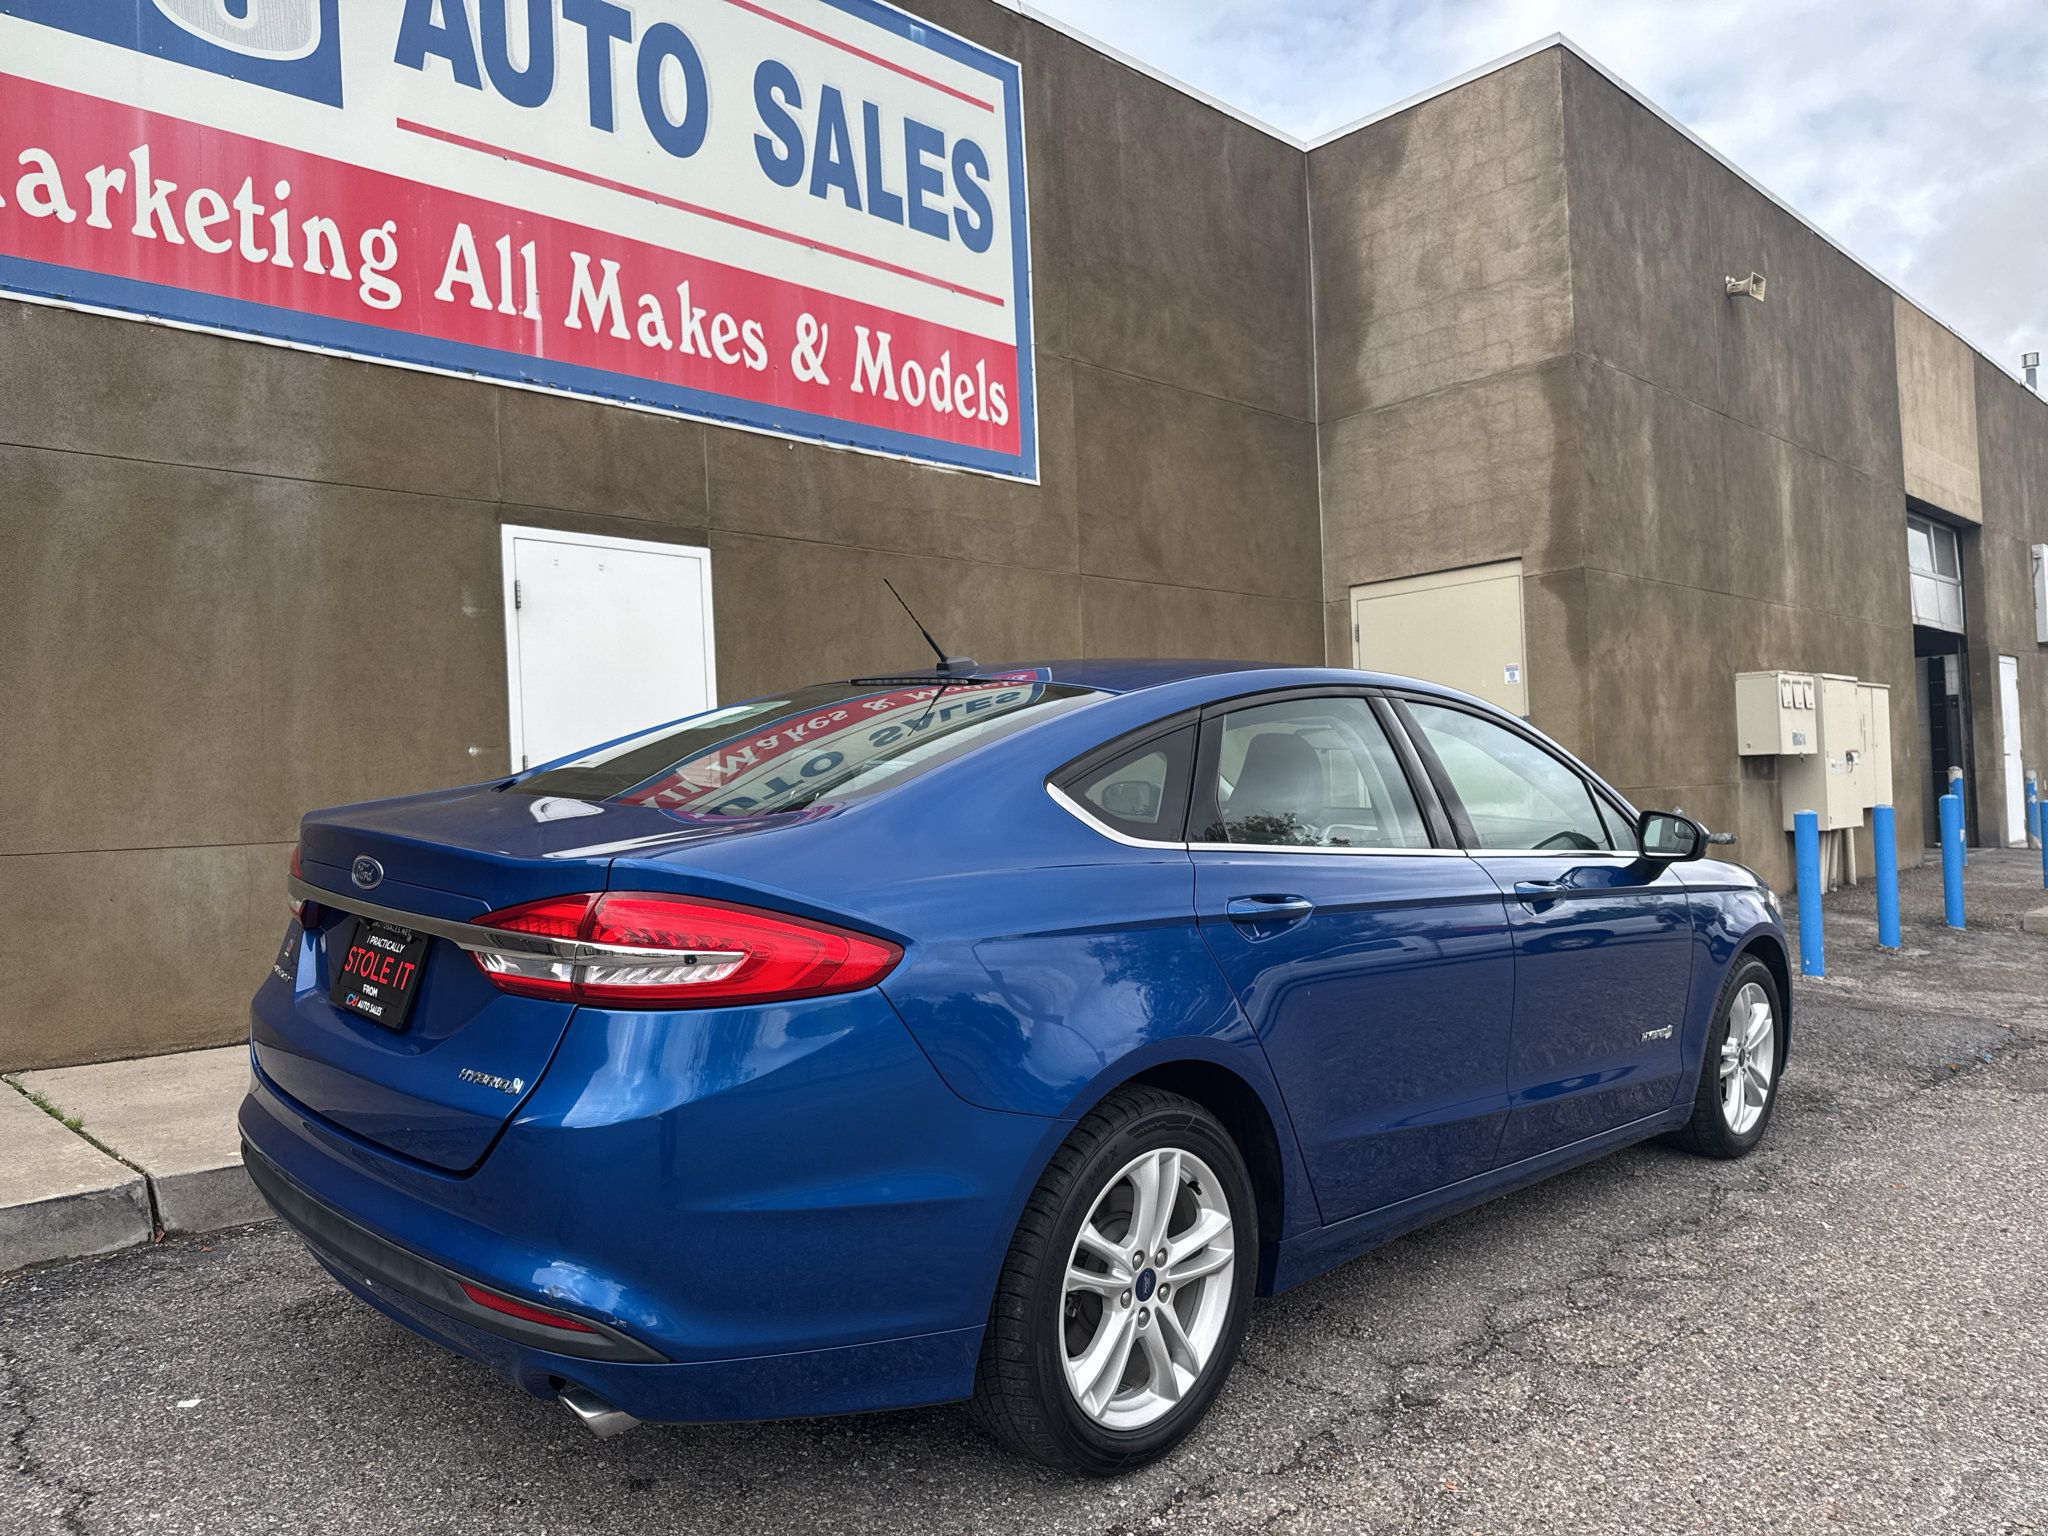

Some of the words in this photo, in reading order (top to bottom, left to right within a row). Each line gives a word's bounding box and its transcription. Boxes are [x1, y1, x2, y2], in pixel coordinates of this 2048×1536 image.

[393, 0, 710, 158] AUTO
[753, 59, 994, 254] SALES
[0, 144, 402, 311] arketing
[434, 222, 542, 320] All
[563, 251, 768, 372] Makes
[791, 312, 830, 386] &
[850, 325, 1009, 427] Models
[366, 935, 371, 943] I
[370, 935, 406, 953] PRACTICALLY
[344, 946, 395, 984] STOLE
[393, 961, 415, 990] IT
[362, 983, 378, 997] FROM
[357, 1000, 371, 1012] AUTO
[369, 1003, 383, 1016] SALES
